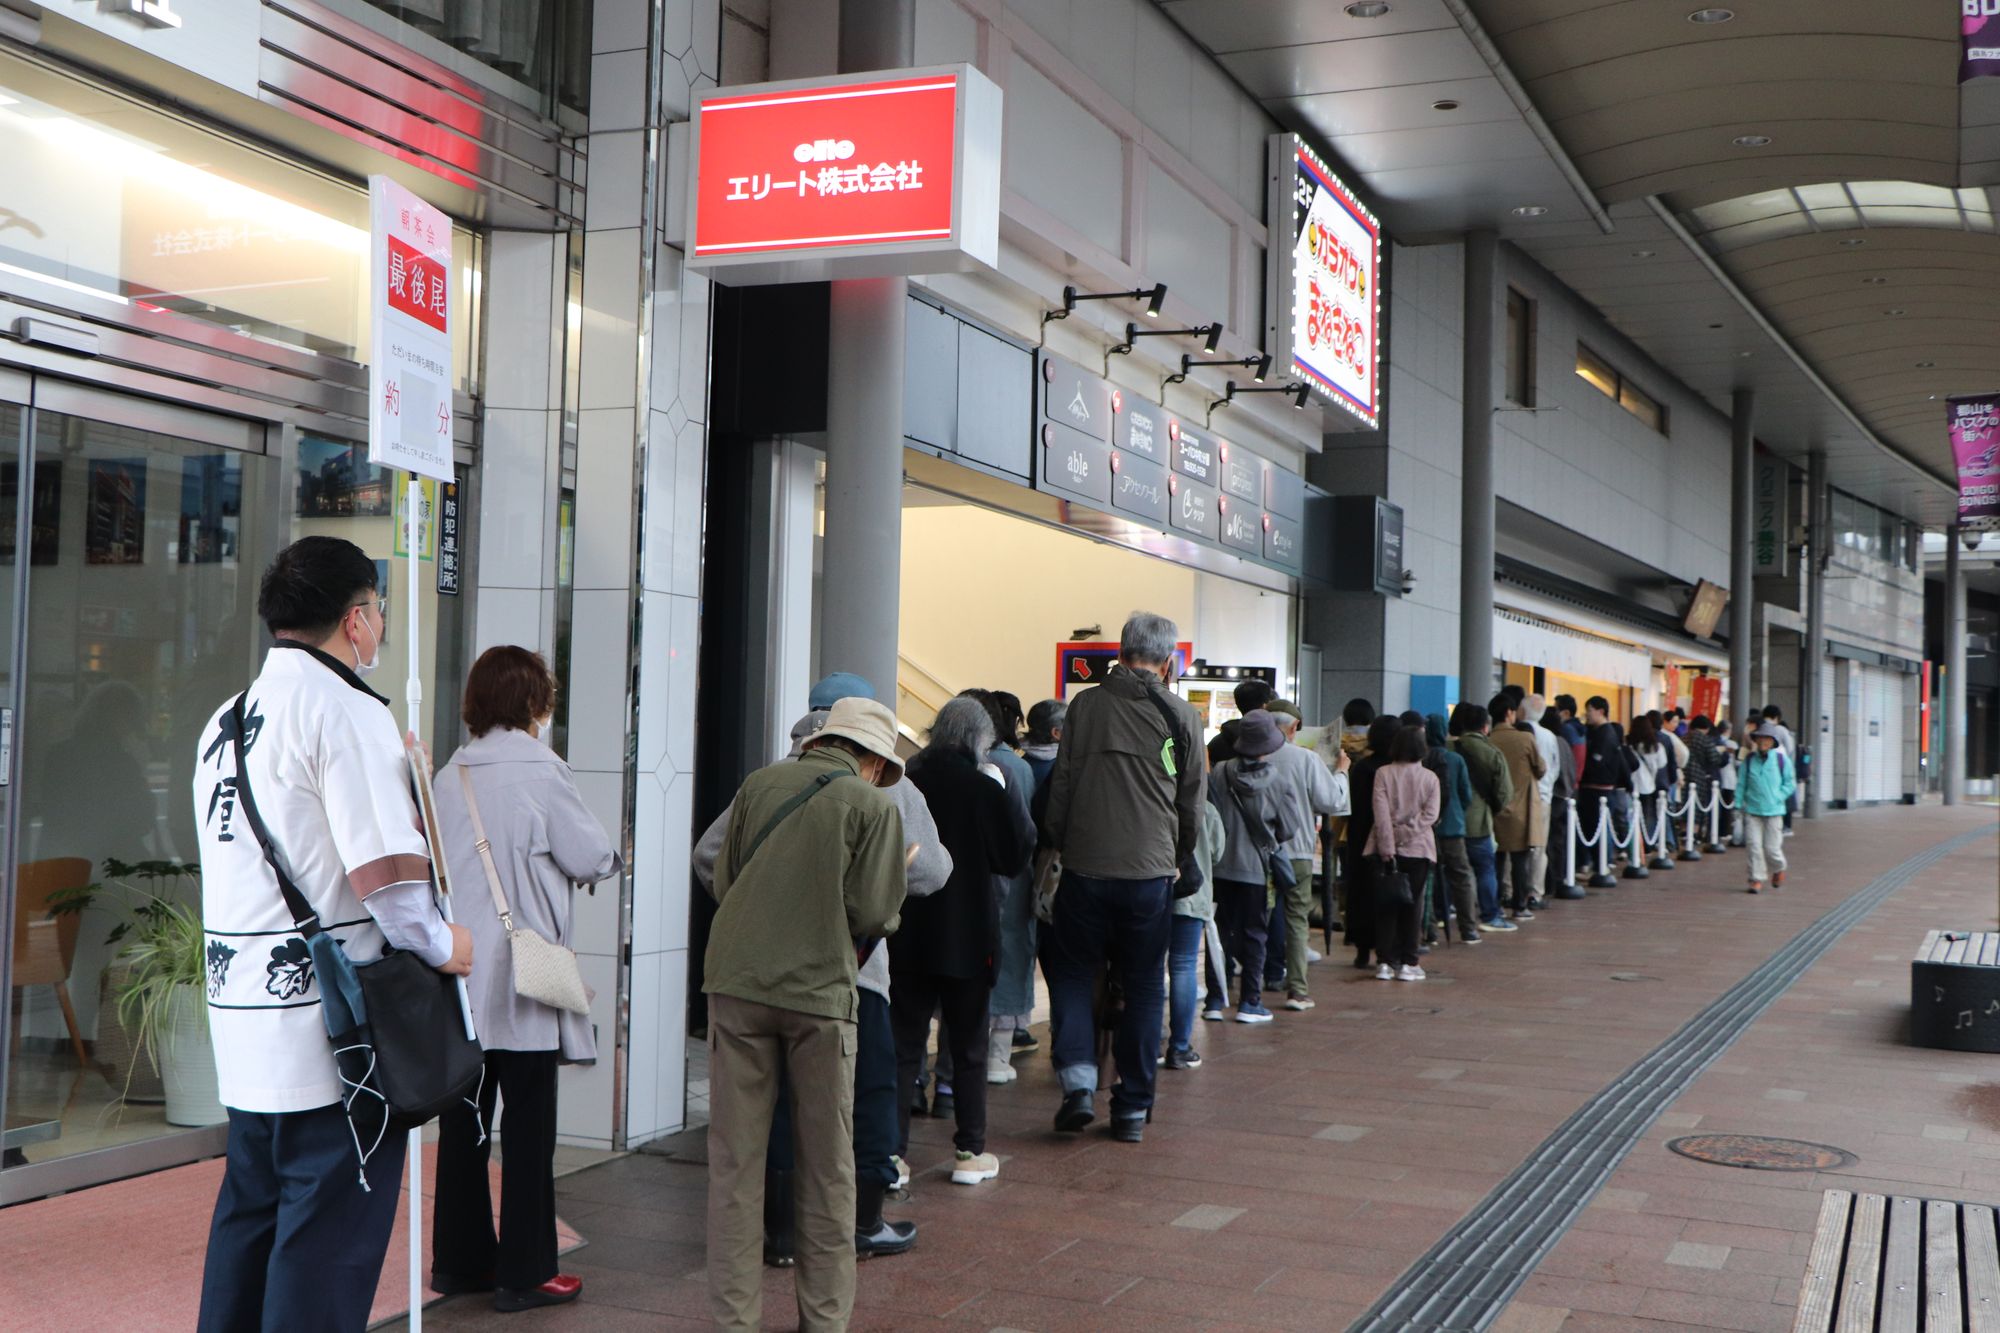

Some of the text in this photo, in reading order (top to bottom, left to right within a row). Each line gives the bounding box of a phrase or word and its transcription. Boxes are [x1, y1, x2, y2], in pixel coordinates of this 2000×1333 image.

[726, 160, 923, 200] エリート株式会社
[1298, 177, 1313, 209] 2F
[401, 208, 435, 247] 朝茶会
[1316, 218, 1359, 293] カラオケ
[389, 251, 446, 317] 最後尾
[1307, 270, 1365, 379] まねきねこ
[385, 379, 450, 435] 約 分
[1953, 416, 1999, 431] バスケの
[1067, 450, 1088, 478] able
[442, 500, 457, 589] 防犯連絡所
